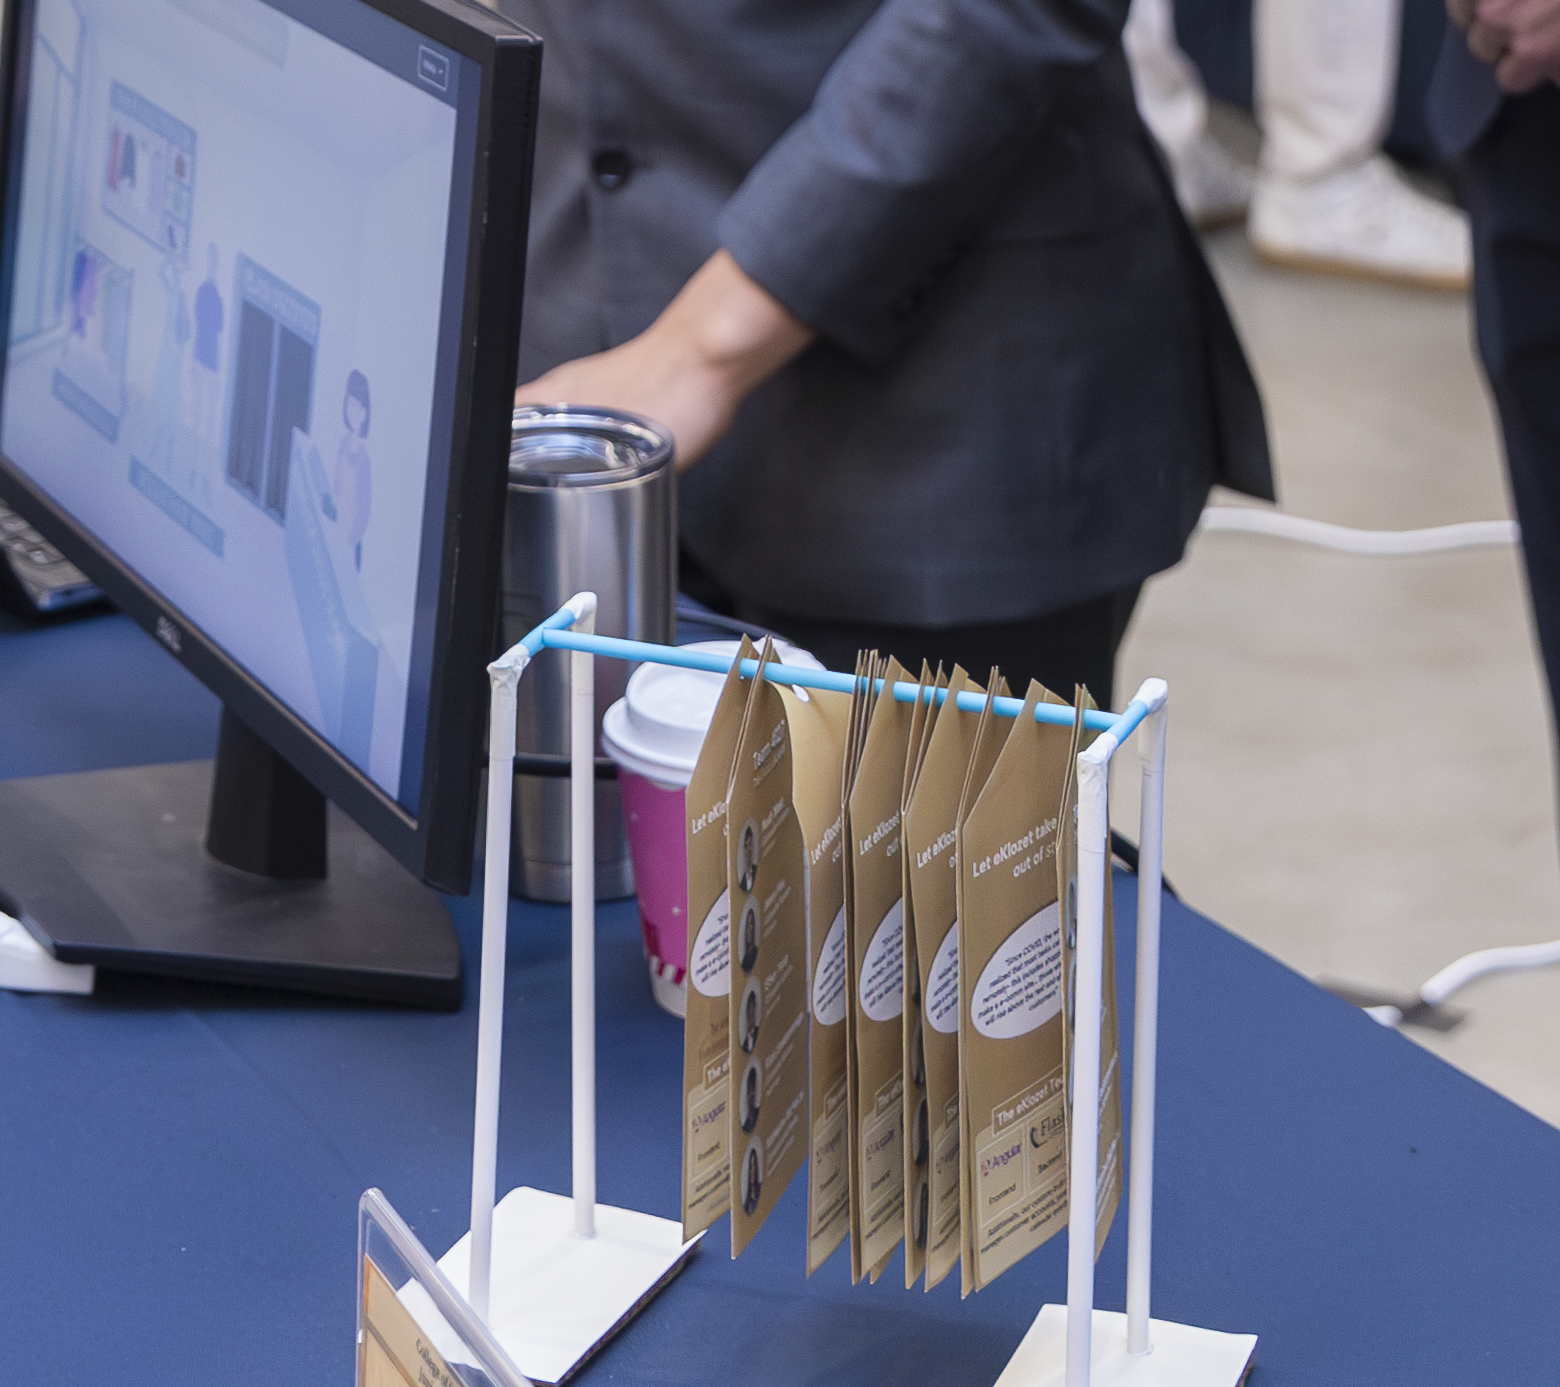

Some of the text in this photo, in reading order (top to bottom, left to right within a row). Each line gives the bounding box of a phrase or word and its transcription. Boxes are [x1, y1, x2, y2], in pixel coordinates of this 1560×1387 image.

[973, 857, 990, 878] Let
[993, 830, 1033, 865] eKlozet
[1013, 857, 1031, 877] out
[1033, 846, 1043, 864] of
[997, 1109, 1015, 1127] The
[992, 1142, 1022, 1169] Angular
